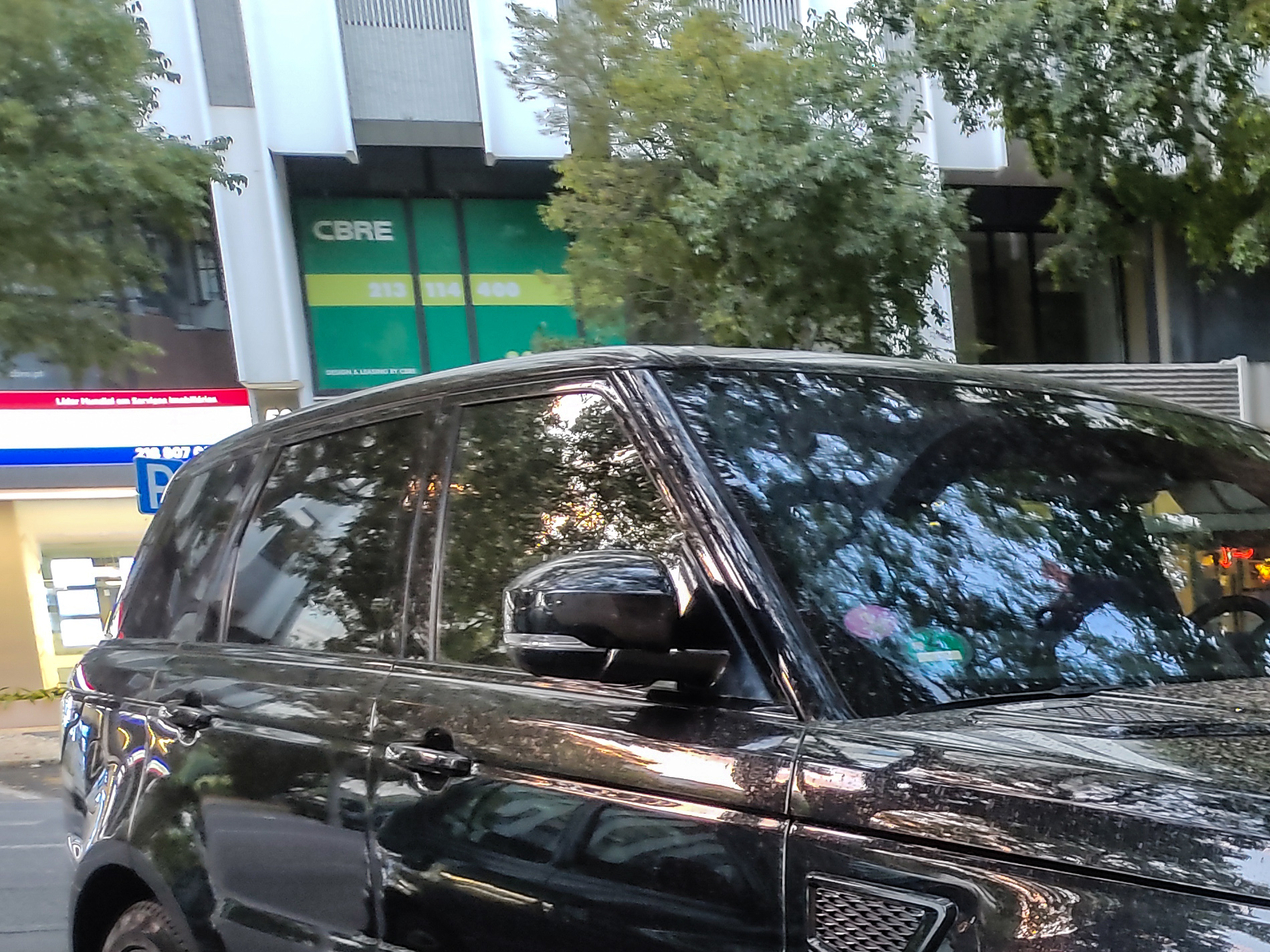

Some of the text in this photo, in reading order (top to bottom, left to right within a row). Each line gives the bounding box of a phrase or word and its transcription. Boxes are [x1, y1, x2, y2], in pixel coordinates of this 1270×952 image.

[313, 220, 393, 241] CBRE
[368, 282, 407, 298] 213
[146, 463, 174, 509] P
